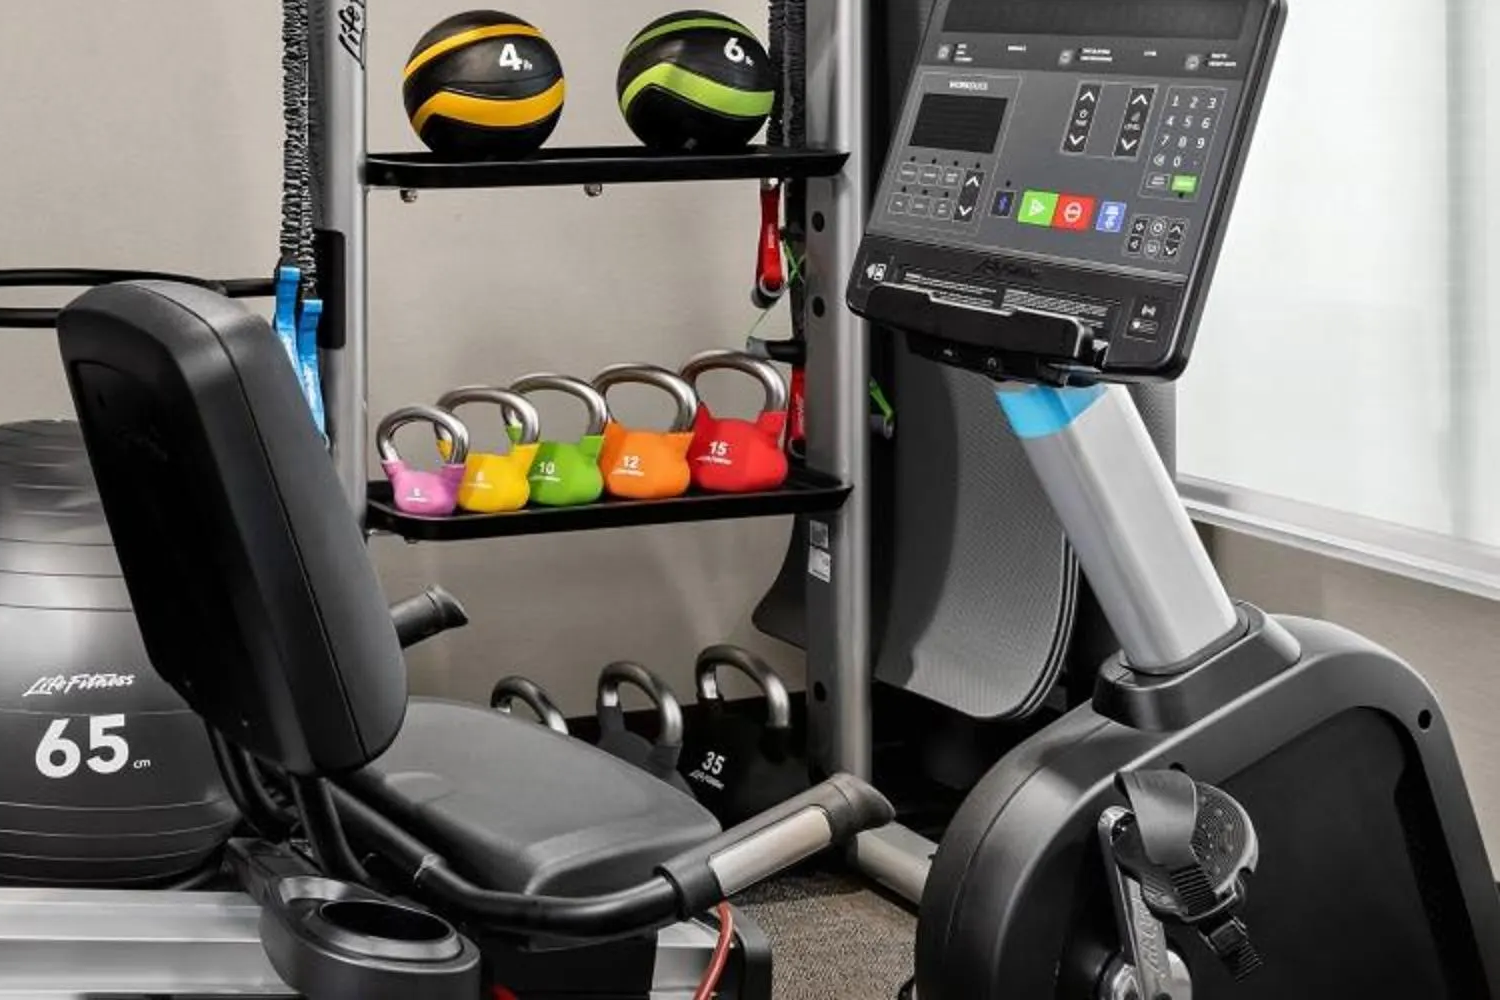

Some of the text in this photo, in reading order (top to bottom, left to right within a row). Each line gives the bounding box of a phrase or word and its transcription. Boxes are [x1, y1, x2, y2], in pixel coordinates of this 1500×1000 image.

[499, 43, 522, 70] 4
[724, 37, 745, 62] 6
[709, 440, 729, 457] 15
[539, 460, 556, 475] 10
[623, 455, 640, 469] 12
[35, 713, 129, 779] 65
[701, 751, 725, 775] 35
